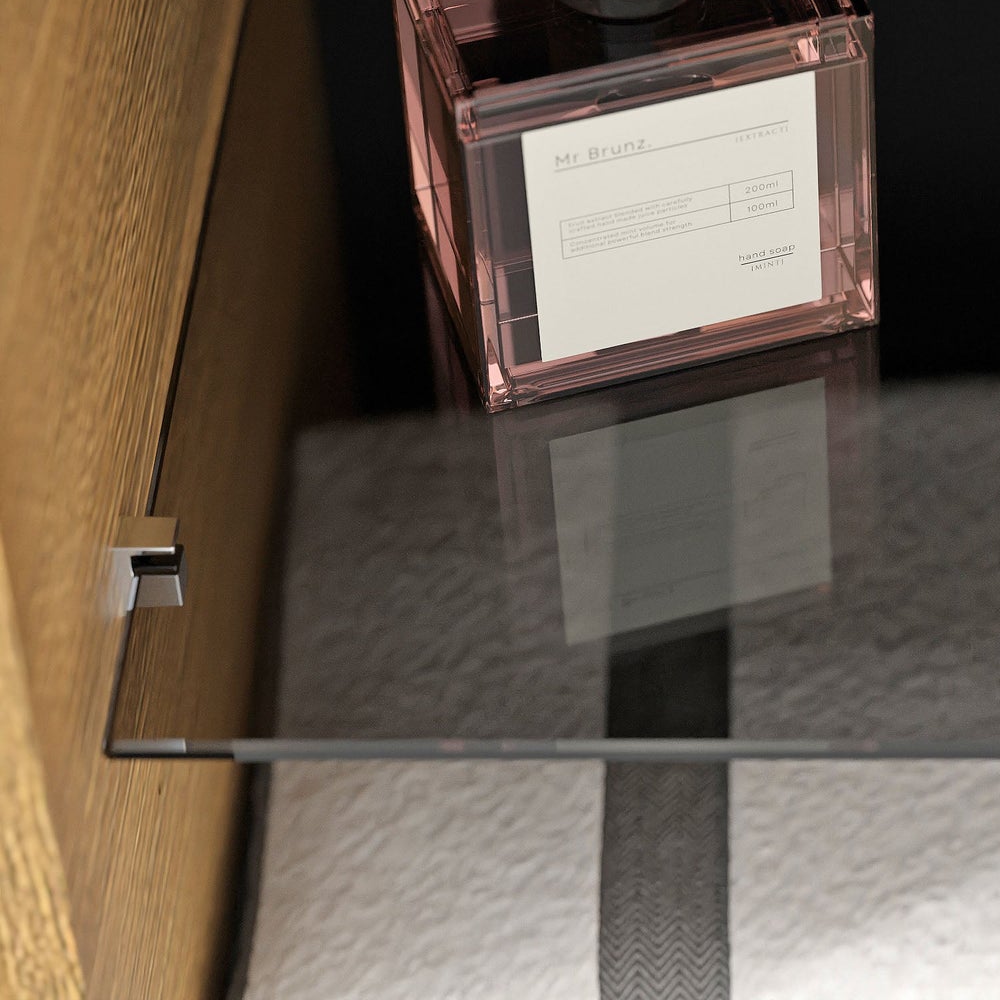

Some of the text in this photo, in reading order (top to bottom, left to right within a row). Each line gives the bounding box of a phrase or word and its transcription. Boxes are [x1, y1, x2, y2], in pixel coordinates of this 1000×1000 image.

[554, 138, 653, 168] Mr Brunz.
[744, 180, 779, 194] 200ml
[747, 199, 779, 213] 100ml
[738, 244, 796, 262] hand soap
